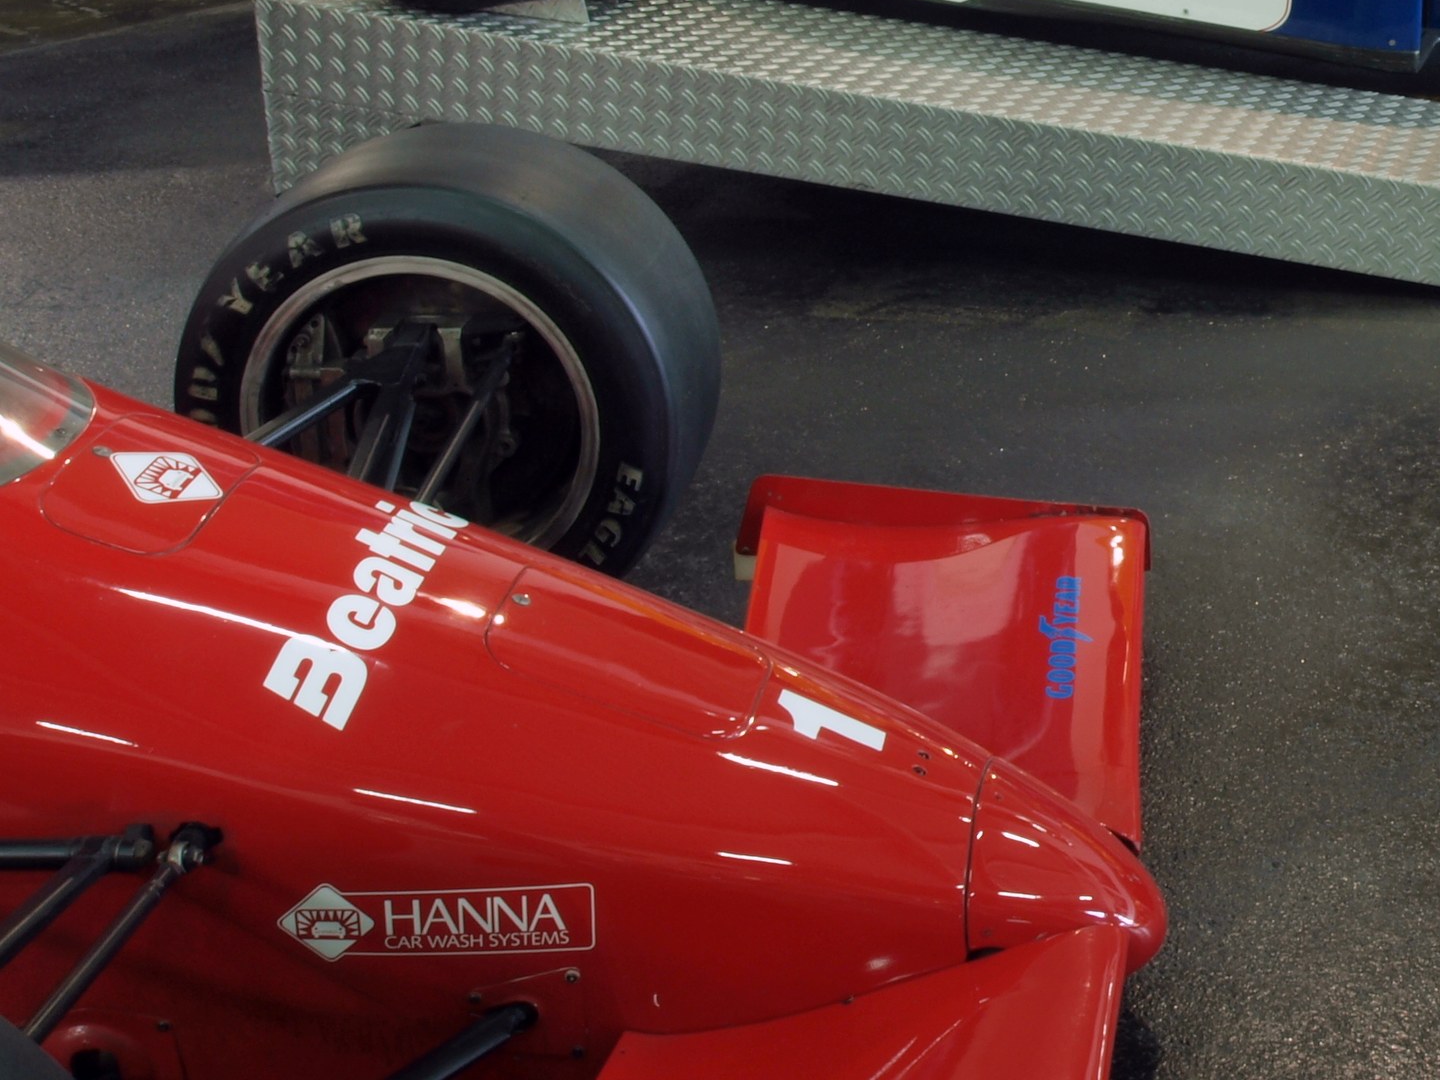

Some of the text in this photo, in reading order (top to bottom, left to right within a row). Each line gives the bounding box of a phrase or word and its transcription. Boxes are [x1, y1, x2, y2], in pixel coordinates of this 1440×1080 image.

[777, 688, 887, 751] 1
[383, 892, 568, 935] HANNA
[384, 928, 571, 949] CAR WASH SYSTEMS
